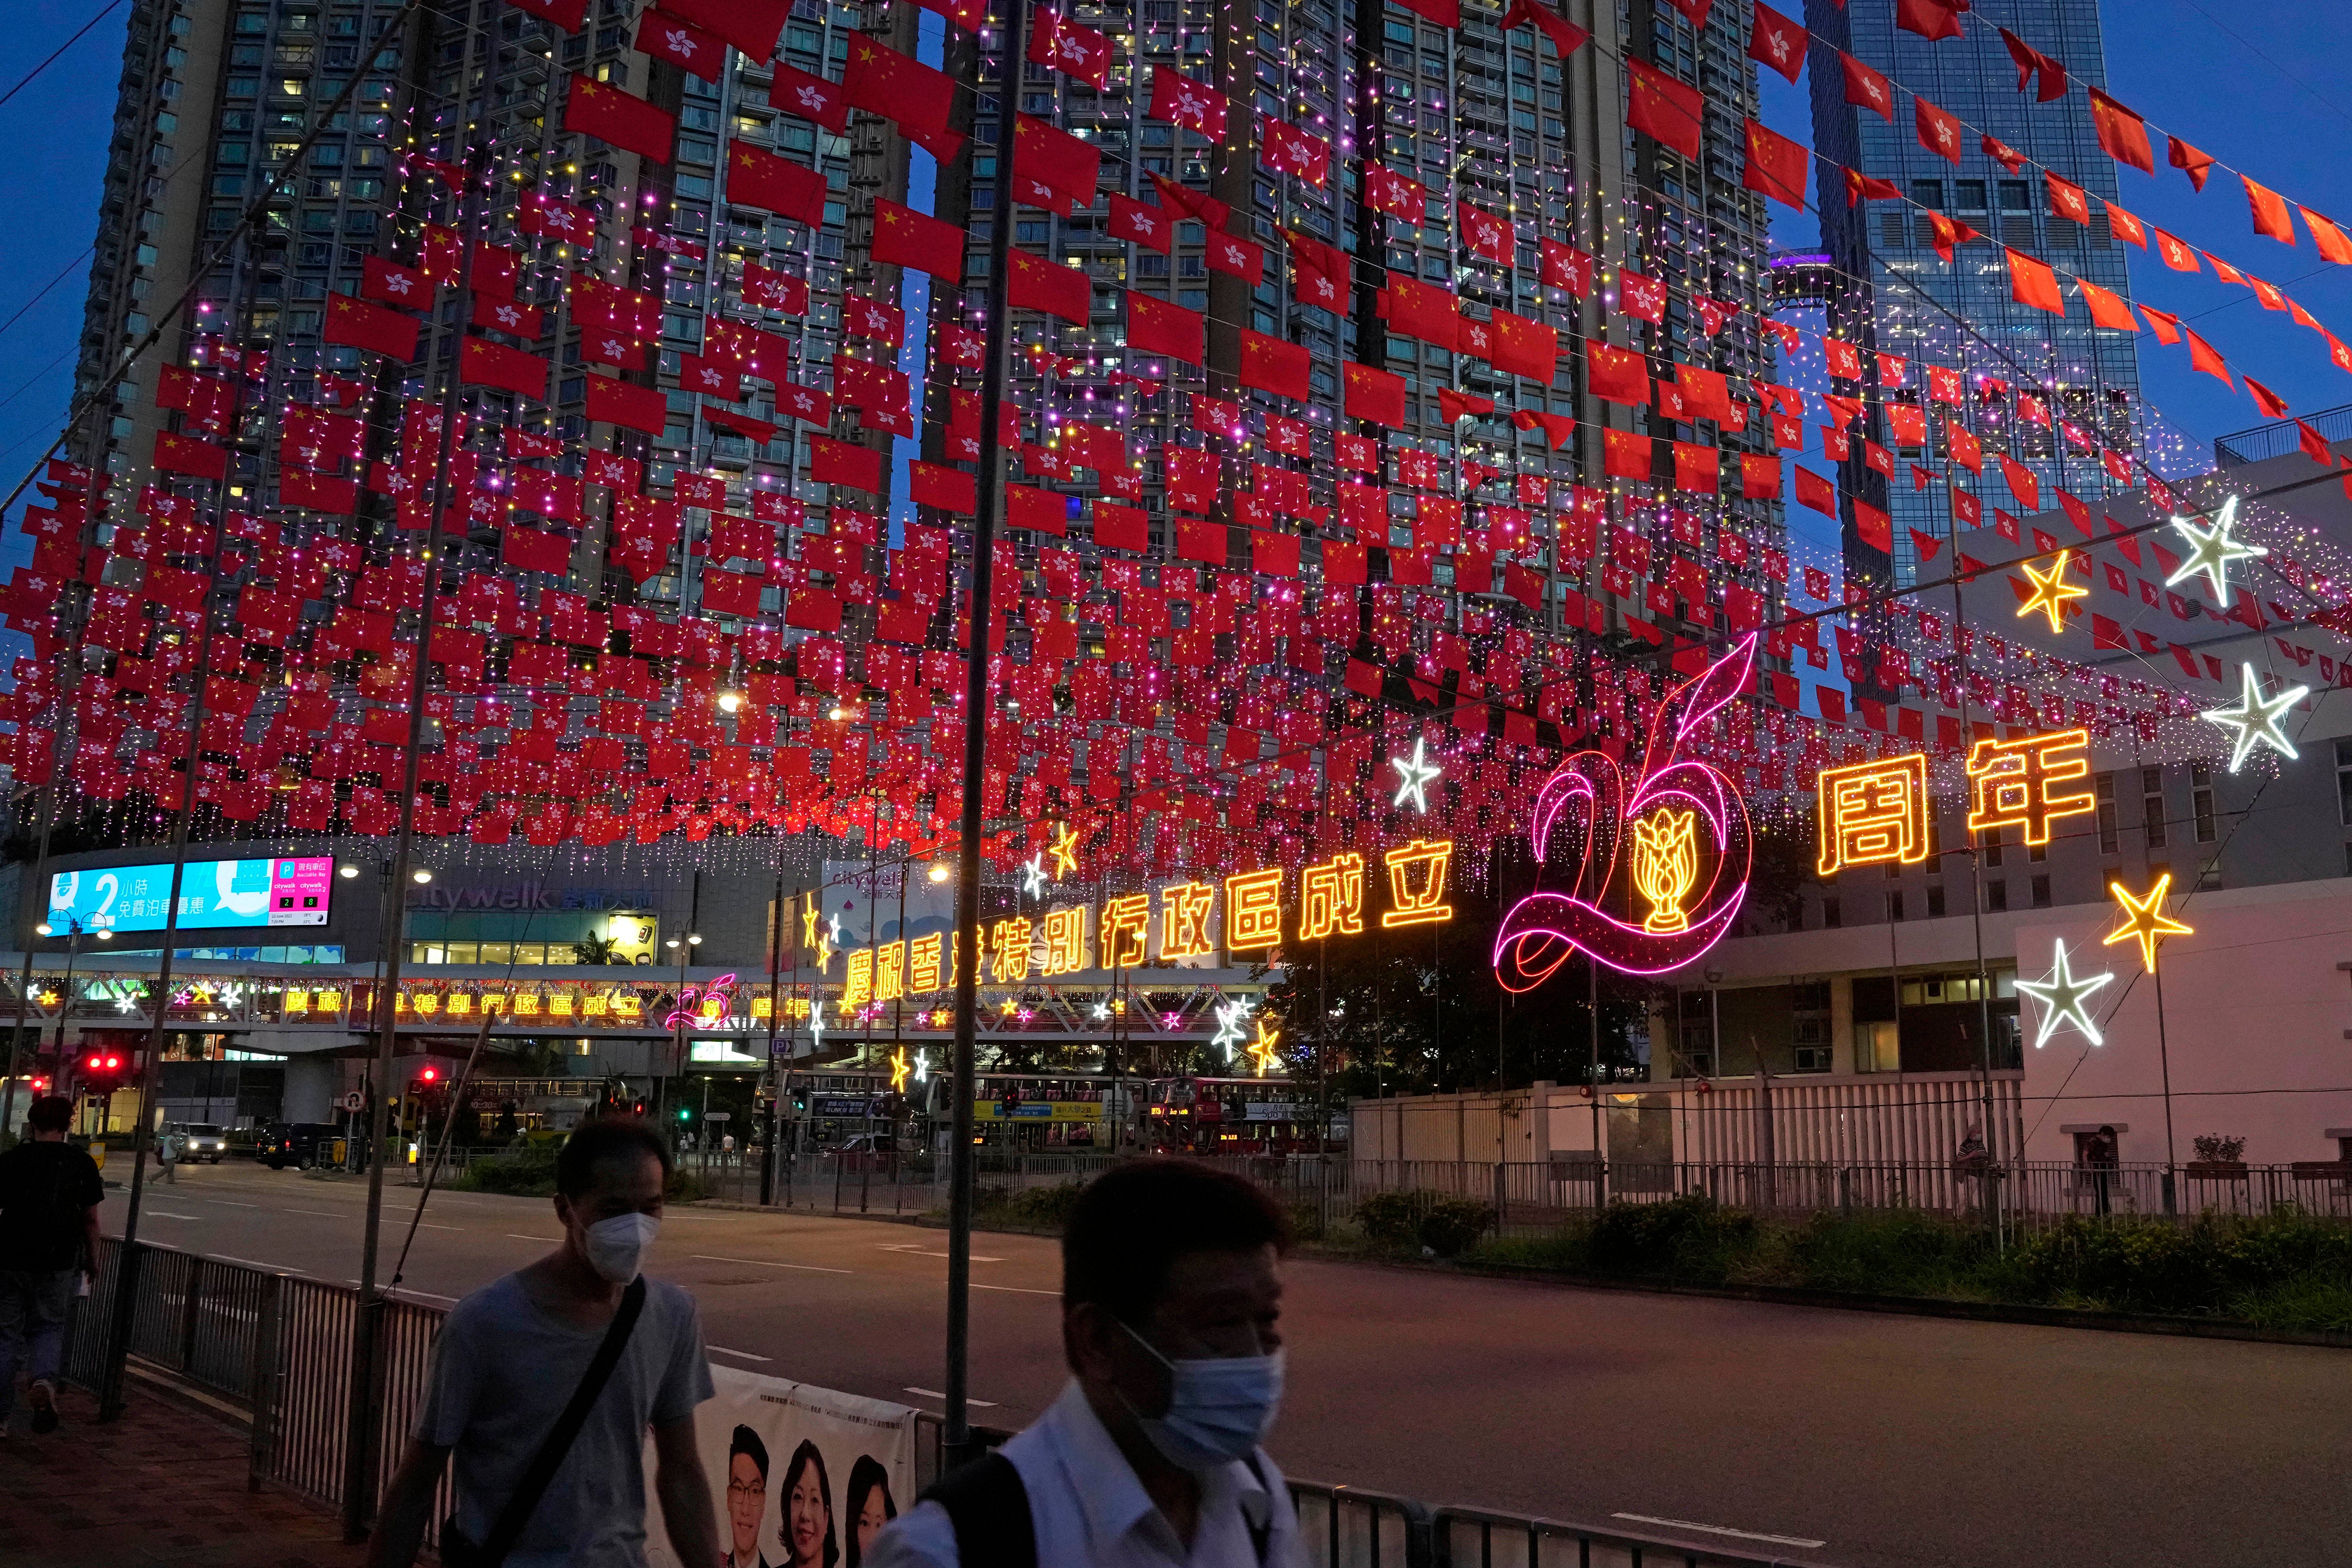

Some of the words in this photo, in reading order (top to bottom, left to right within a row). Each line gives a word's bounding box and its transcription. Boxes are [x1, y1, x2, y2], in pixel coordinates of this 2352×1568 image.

[1818, 728, 2096, 876] 周年
[284, 865, 290, 875] P
[91, 874, 119, 927] 2
[121, 879, 148, 897] 小時
[118, 896, 205, 918] 免費泊車優惠
[752, 997, 810, 1019] 周年
[776, 1041, 784, 1051] P
[1262, 1109, 1278, 1121] Spa
